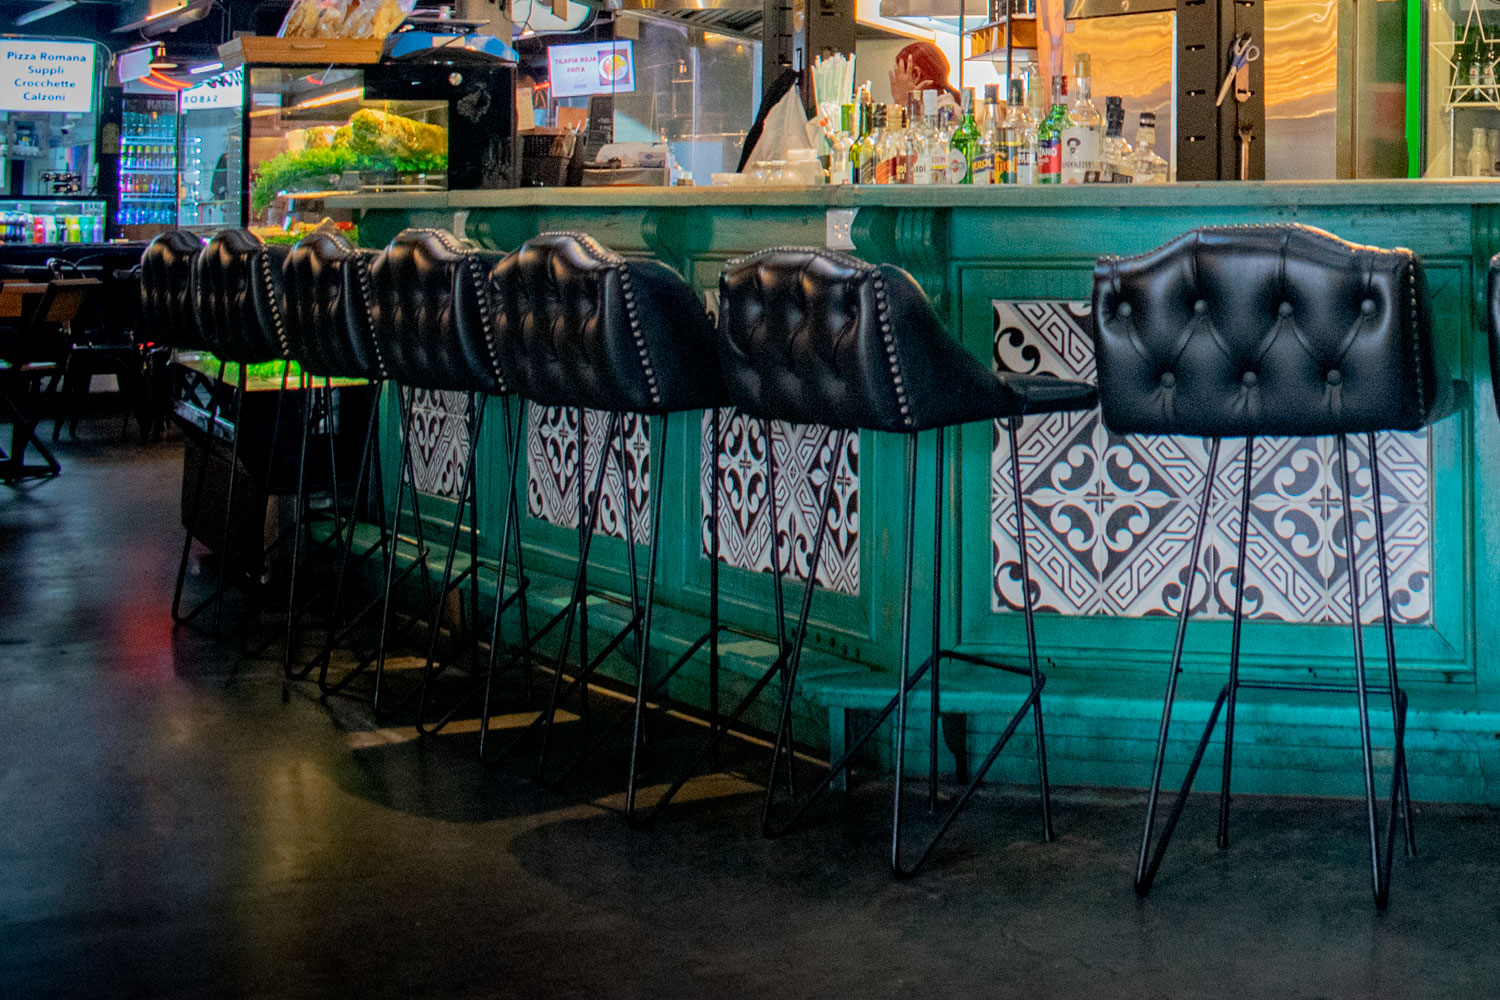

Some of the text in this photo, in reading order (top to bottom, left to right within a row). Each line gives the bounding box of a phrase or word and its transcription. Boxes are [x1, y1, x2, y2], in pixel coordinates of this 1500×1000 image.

[7, 52, 87, 62] Pizza Romana
[14, 78, 76, 88] Crocchette
[23, 91, 66, 101] Calzoni
